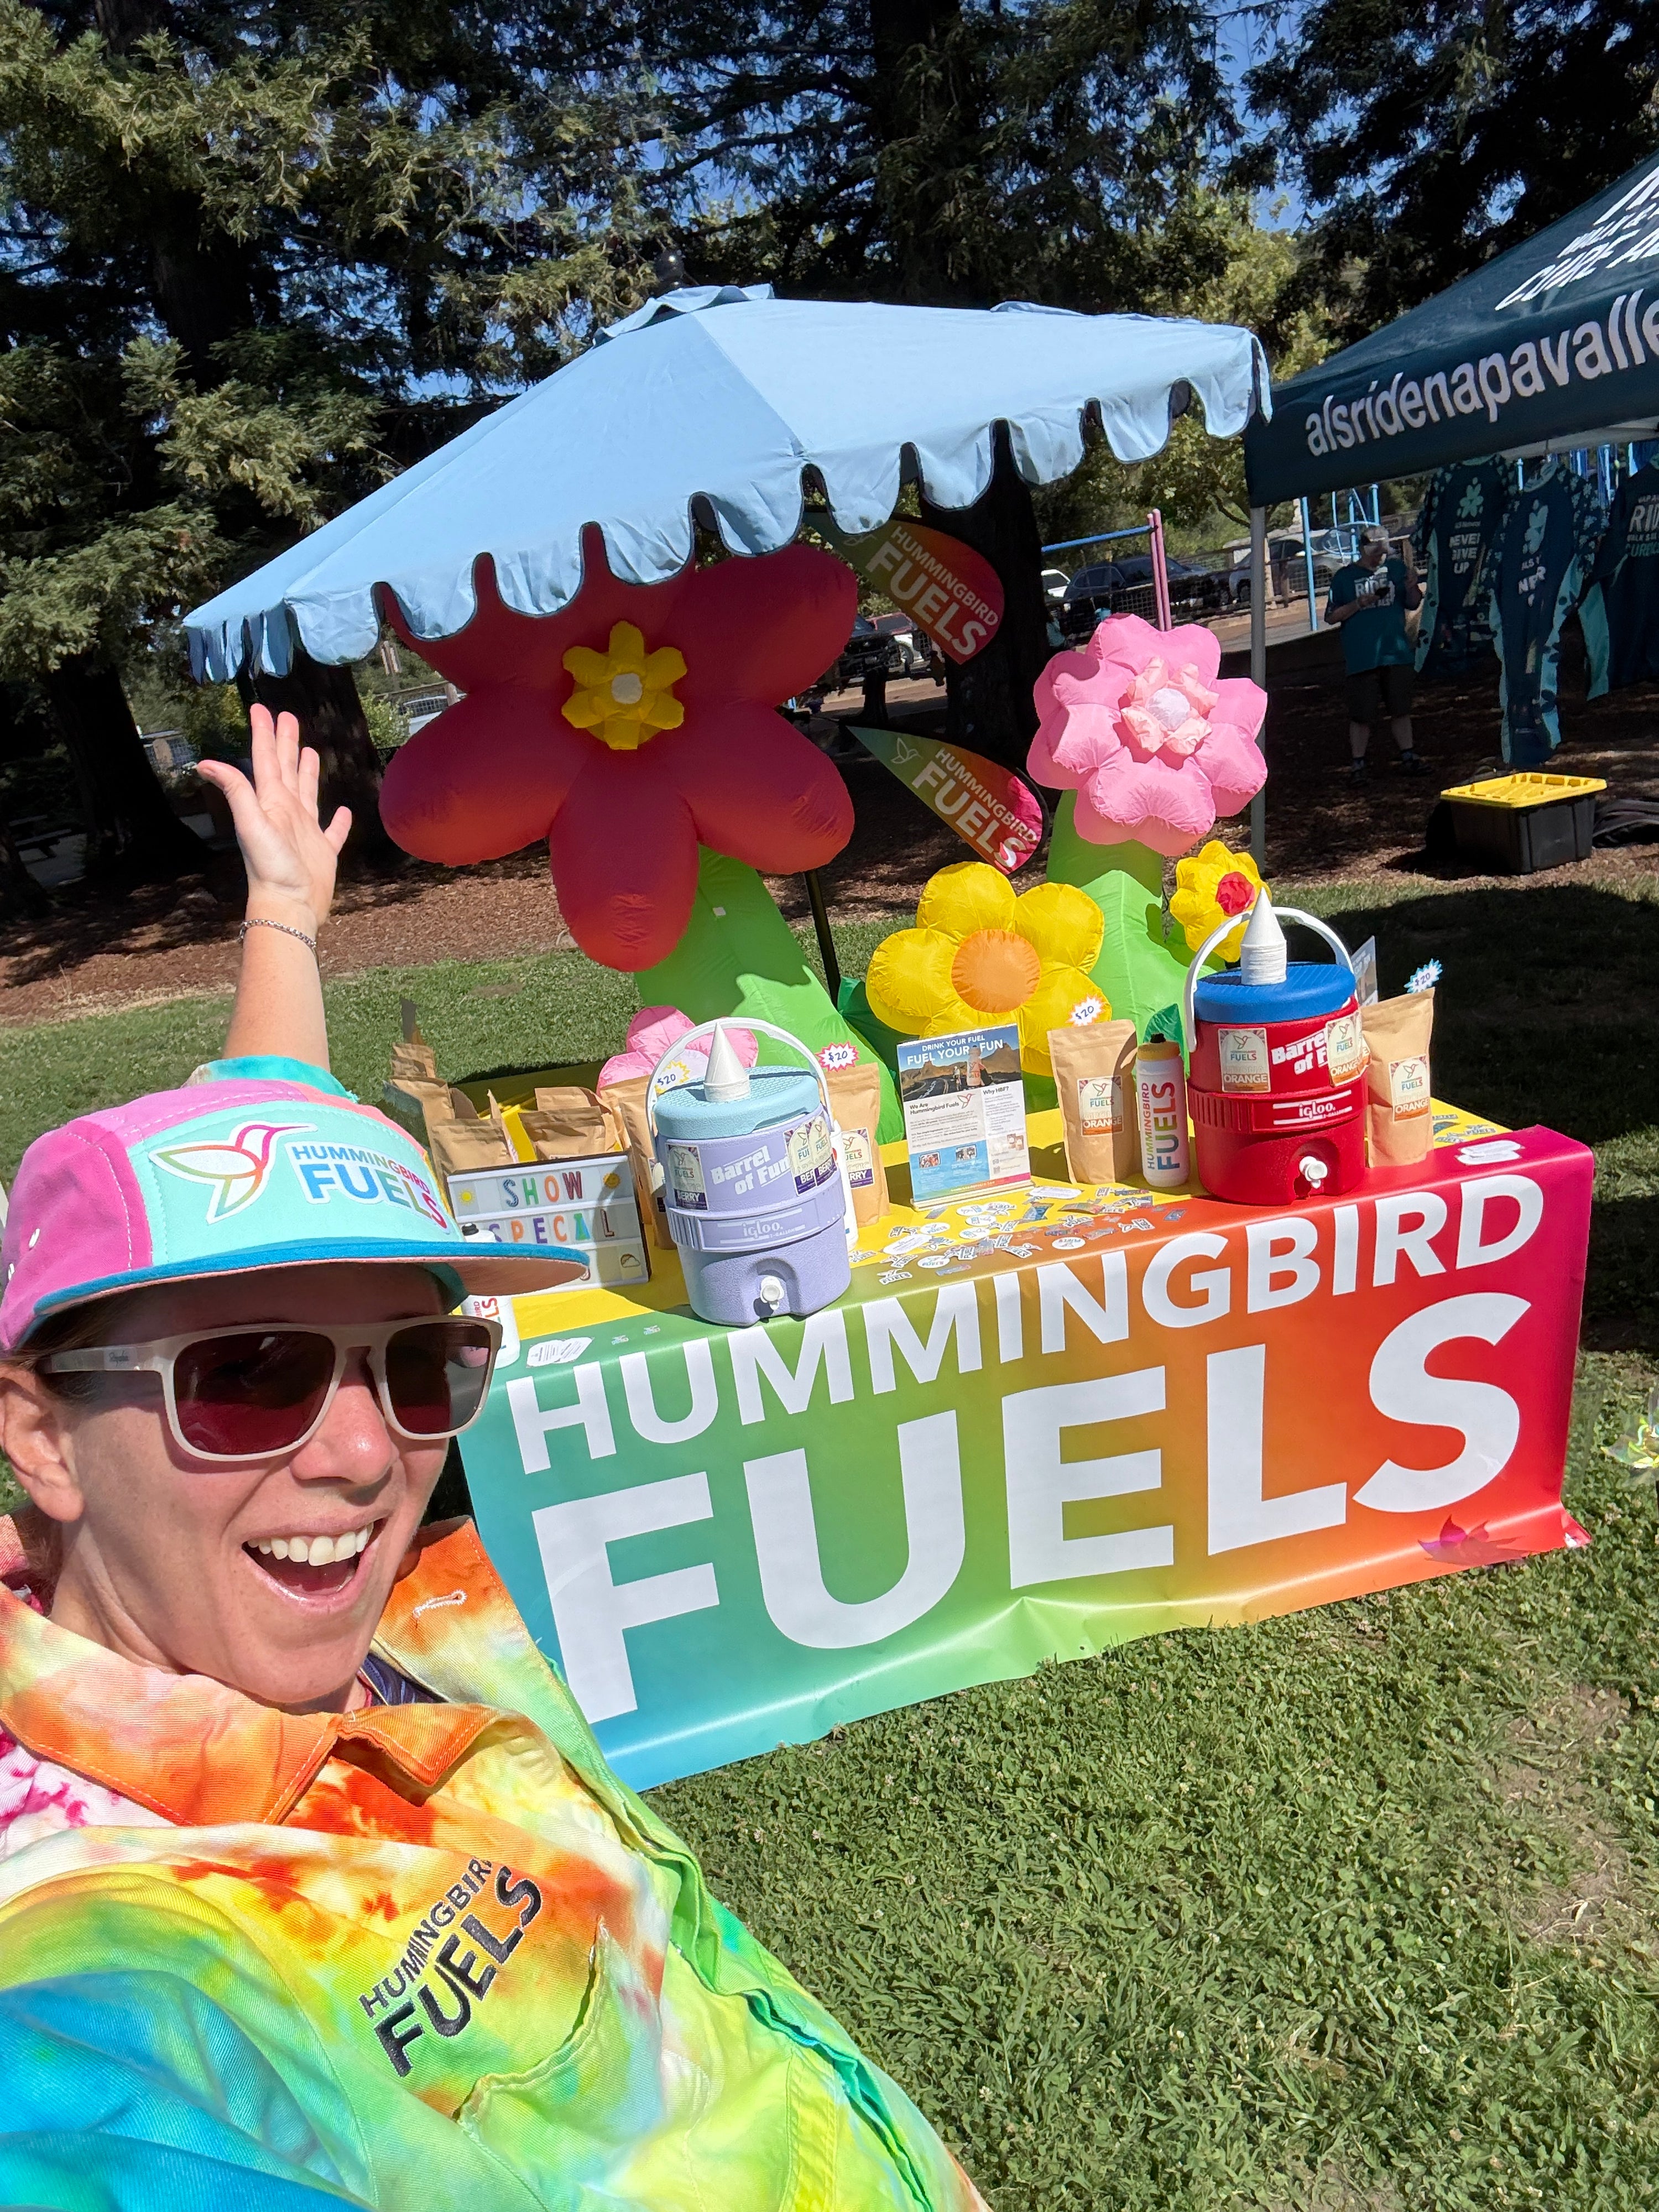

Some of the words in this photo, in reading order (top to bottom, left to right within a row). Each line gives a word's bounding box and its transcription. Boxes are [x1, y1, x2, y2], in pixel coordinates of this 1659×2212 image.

[891, 526, 998, 625] HUMMINGBIRD
[865, 541, 987, 655] FUELS
[935, 748, 1037, 842] HUMMINGBIRD
[912, 760, 1026, 868] FUELS
[1414, 972, 1431, 987] $20
[1075, 1005, 1094, 1020] $20
[828, 1050, 848, 1062] $20
[907, 1054, 935, 1066] FUEL
[937, 1045, 970, 1060] YOUR
[979, 1039, 1004, 1052] FUN
[922, 1042, 945, 1052] DRINK
[946, 1038, 966, 1047] YOUR
[968, 1035, 985, 1044] FUEL
[1337, 1040, 1353, 1052] FUELS
[1230, 1053, 1257, 1062] FUELS
[1294, 1053, 1313, 1074] of
[657, 1073, 676, 1086] $20
[1224, 1074, 1267, 1083] ORANGE
[1401, 1079, 1423, 1091] FUELS
[1090, 1099, 1114, 1107] FUELS
[1395, 1097, 1429, 1114] ORANGE
[1083, 1116, 1122, 1129] ORANGE
[1141, 1082, 1155, 1170] HUMMINGBIRD
[1151, 1082, 1181, 1170] FUELS
[291, 1145, 430, 1194] HUMMINGBIRD
[711, 1145, 771, 1185] Barrel
[734, 1174, 755, 1196] of
[756, 1156, 790, 1185] Fun
[849, 1170, 867, 1181] RRY
[299, 1163, 447, 1229] FUELS
[503, 1171, 583, 1207] SHOW
[508, 1173, 1544, 1474] HUMMINGBIRD
[532, 1293, 1532, 1723] FUELS
[374, 1866, 543, 2078] FUELS
